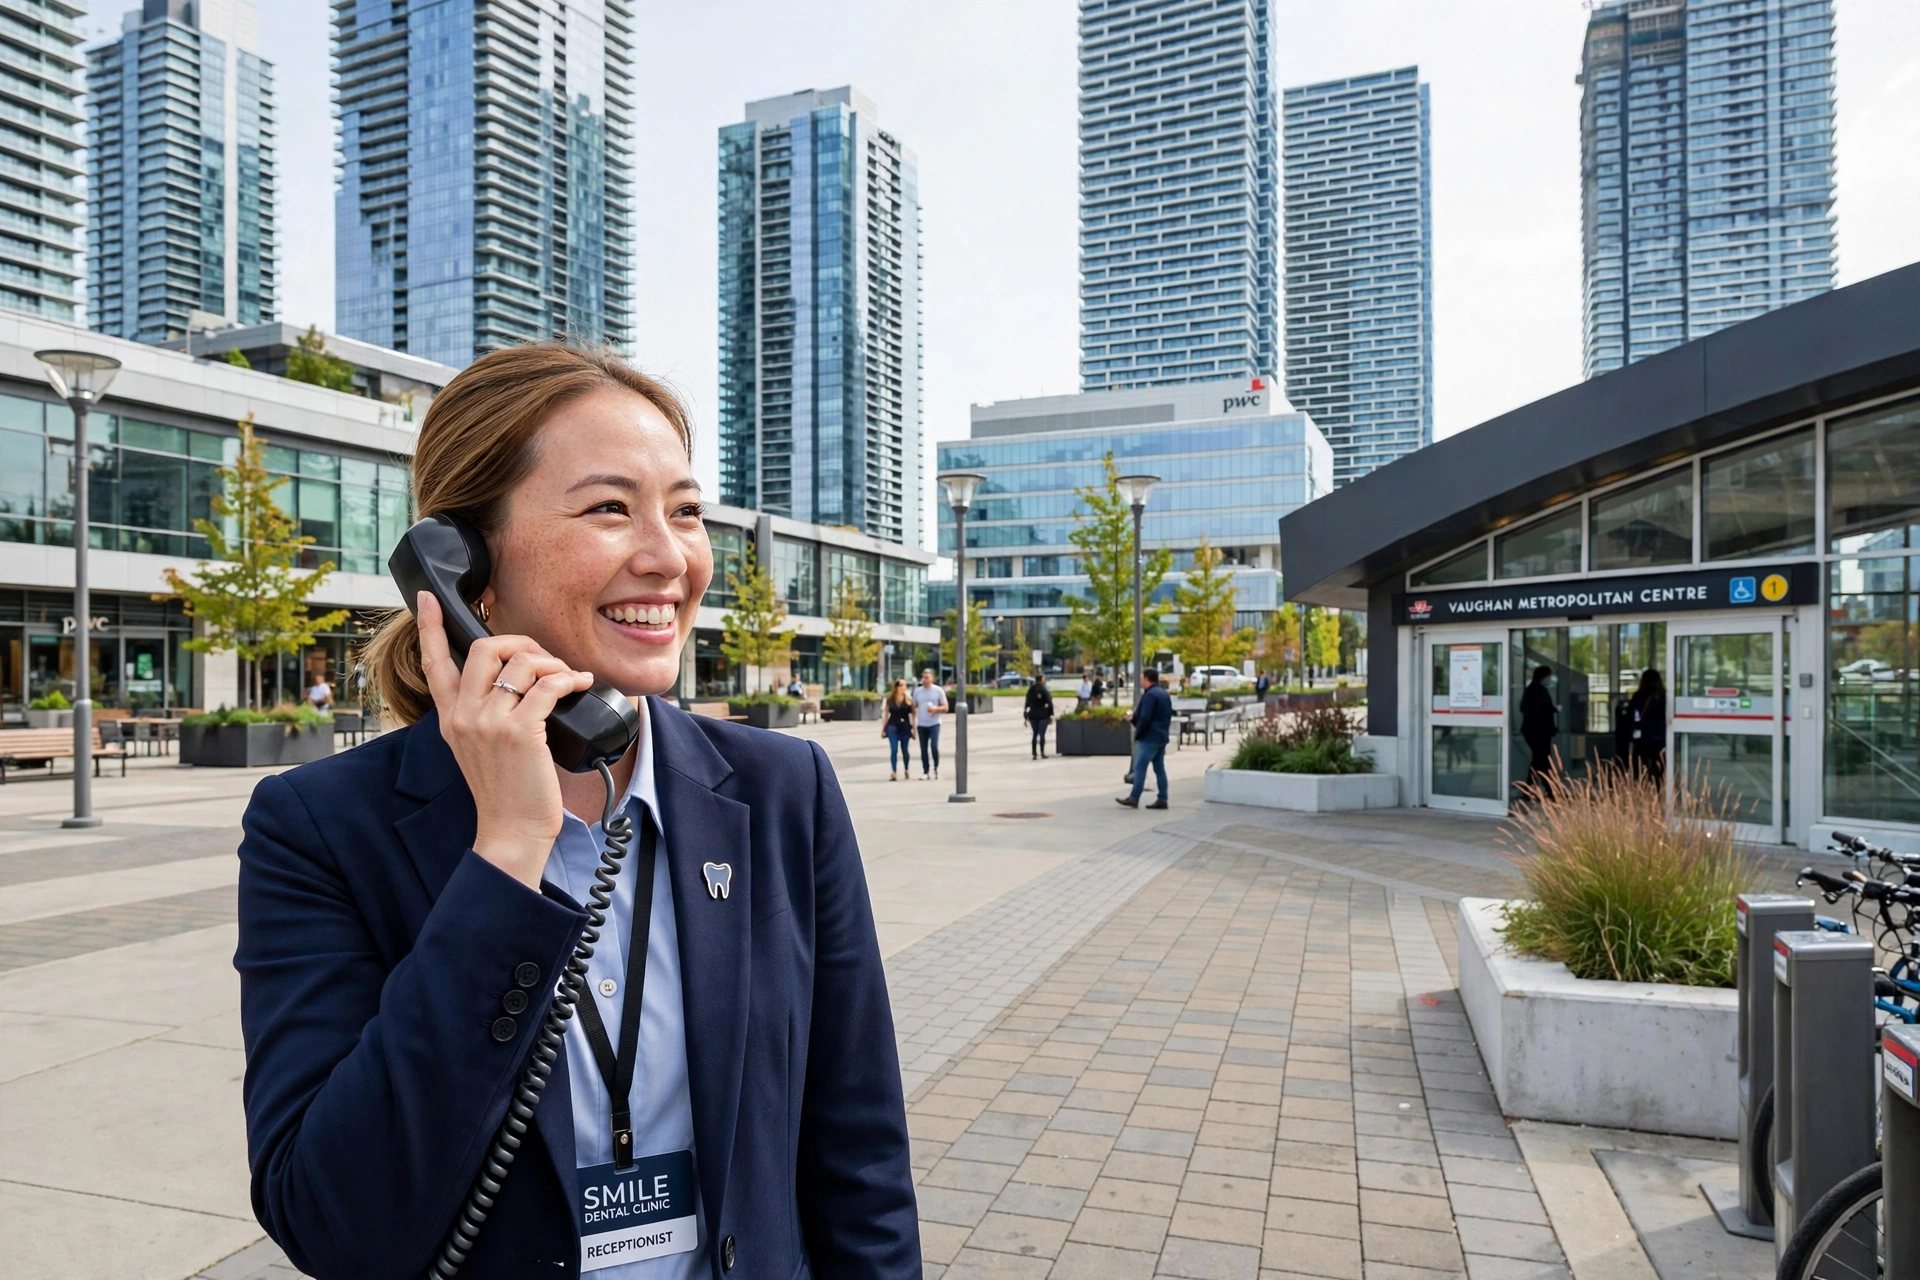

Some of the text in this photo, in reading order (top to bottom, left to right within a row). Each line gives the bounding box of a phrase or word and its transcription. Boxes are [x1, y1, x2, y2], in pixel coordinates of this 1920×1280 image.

[1223, 395, 1260, 413] pwc
[1448, 599, 1513, 614] VAUGHAN
[1518, 590, 1633, 609] METROPOLITAN
[1640, 586, 1708, 603] CENTRE
[584, 1174, 670, 1210] SMILE
[585, 1198, 671, 1223] DENTAL CLINIC
[587, 1231, 673, 1259] RECEPTIONIST
